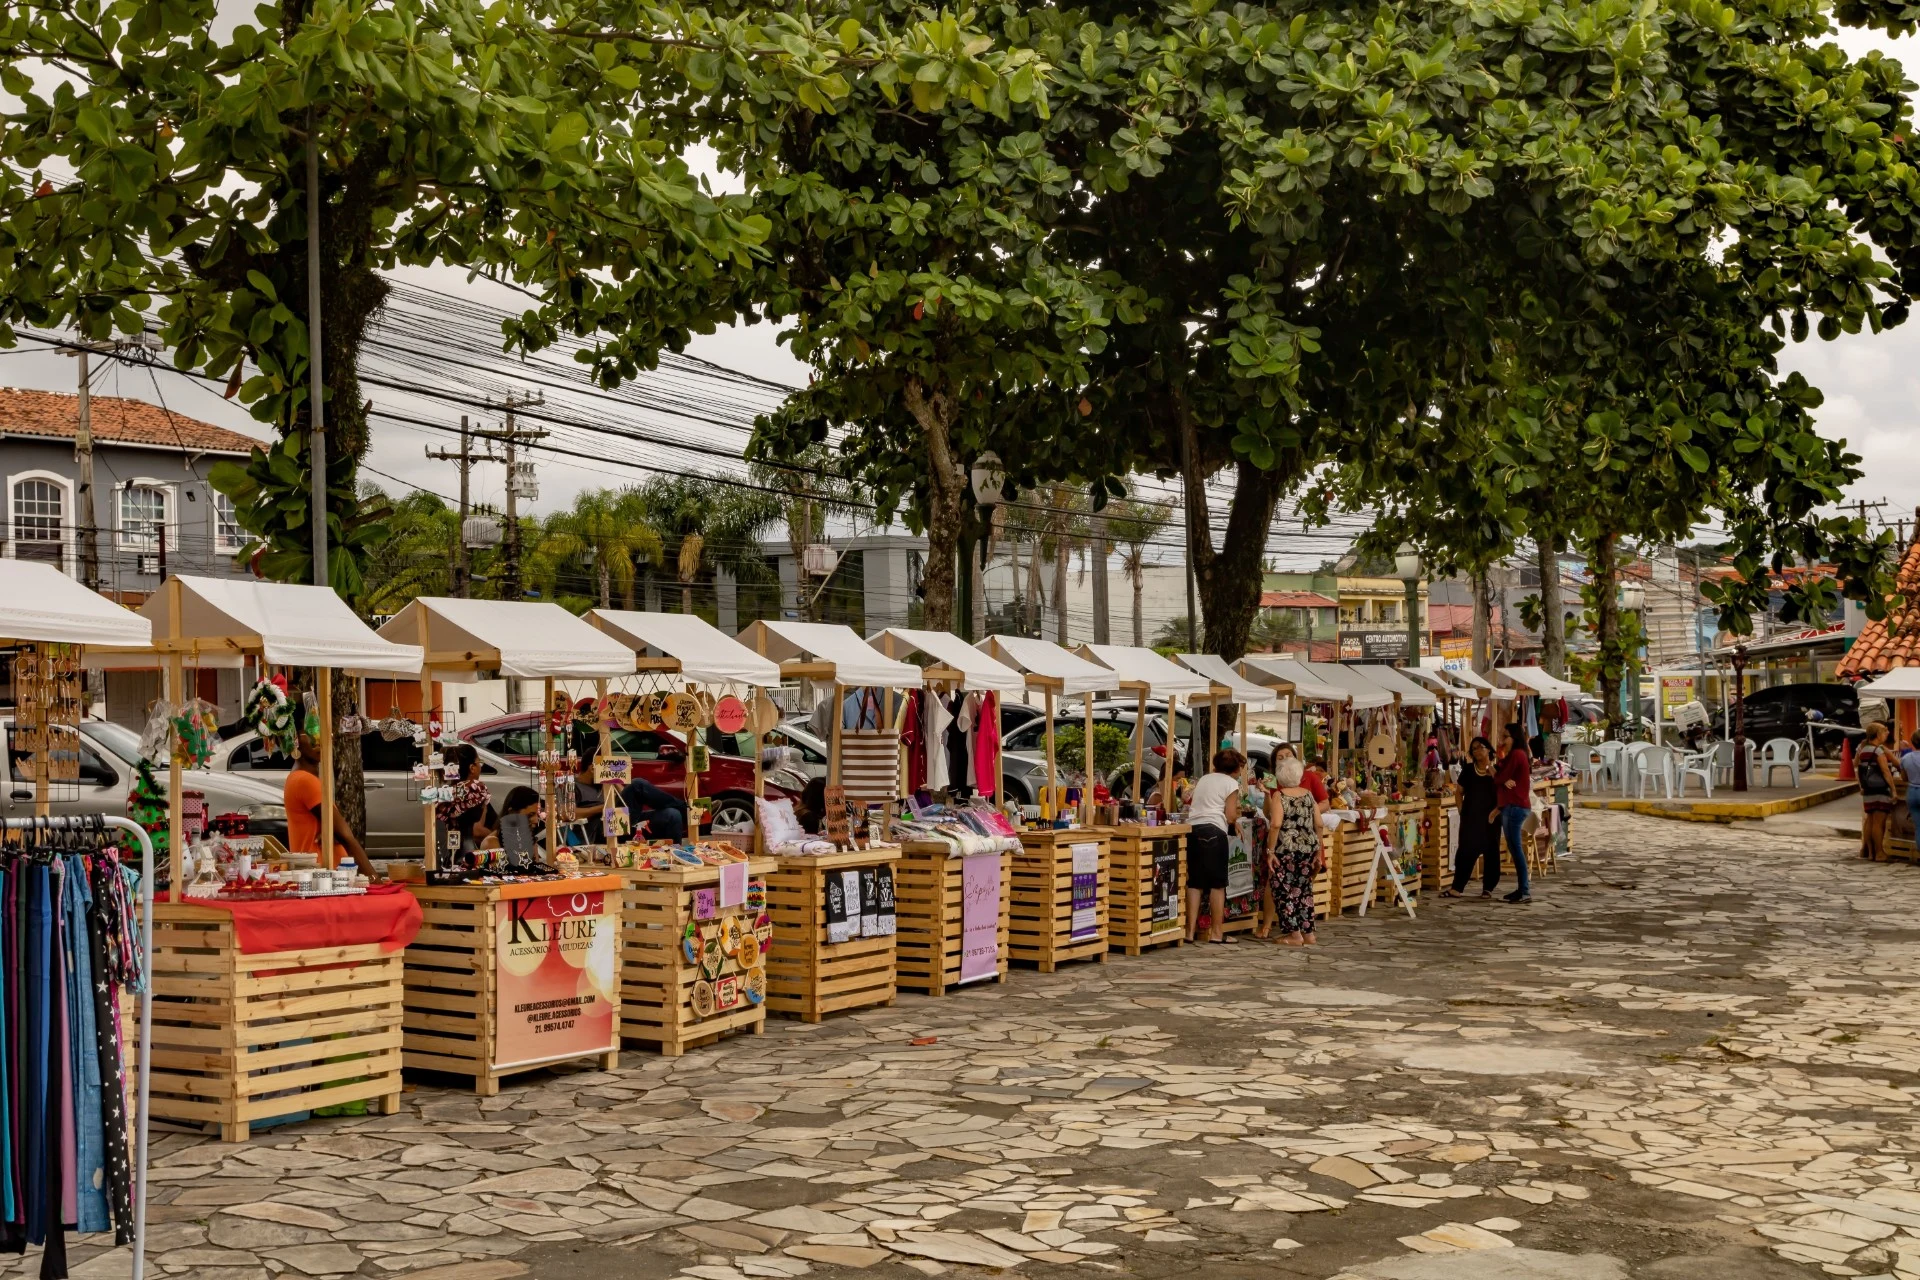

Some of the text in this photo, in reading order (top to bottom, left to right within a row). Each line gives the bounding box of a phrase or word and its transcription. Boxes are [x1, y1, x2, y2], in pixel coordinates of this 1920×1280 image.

[1365, 635, 1381, 643] CENTRO
[1382, 634, 1407, 643] AUTOMOTIVO
[508, 897, 597, 945] KLEURE
[510, 941, 594, 957] ACESSÓRIOS MIUDEZAS
